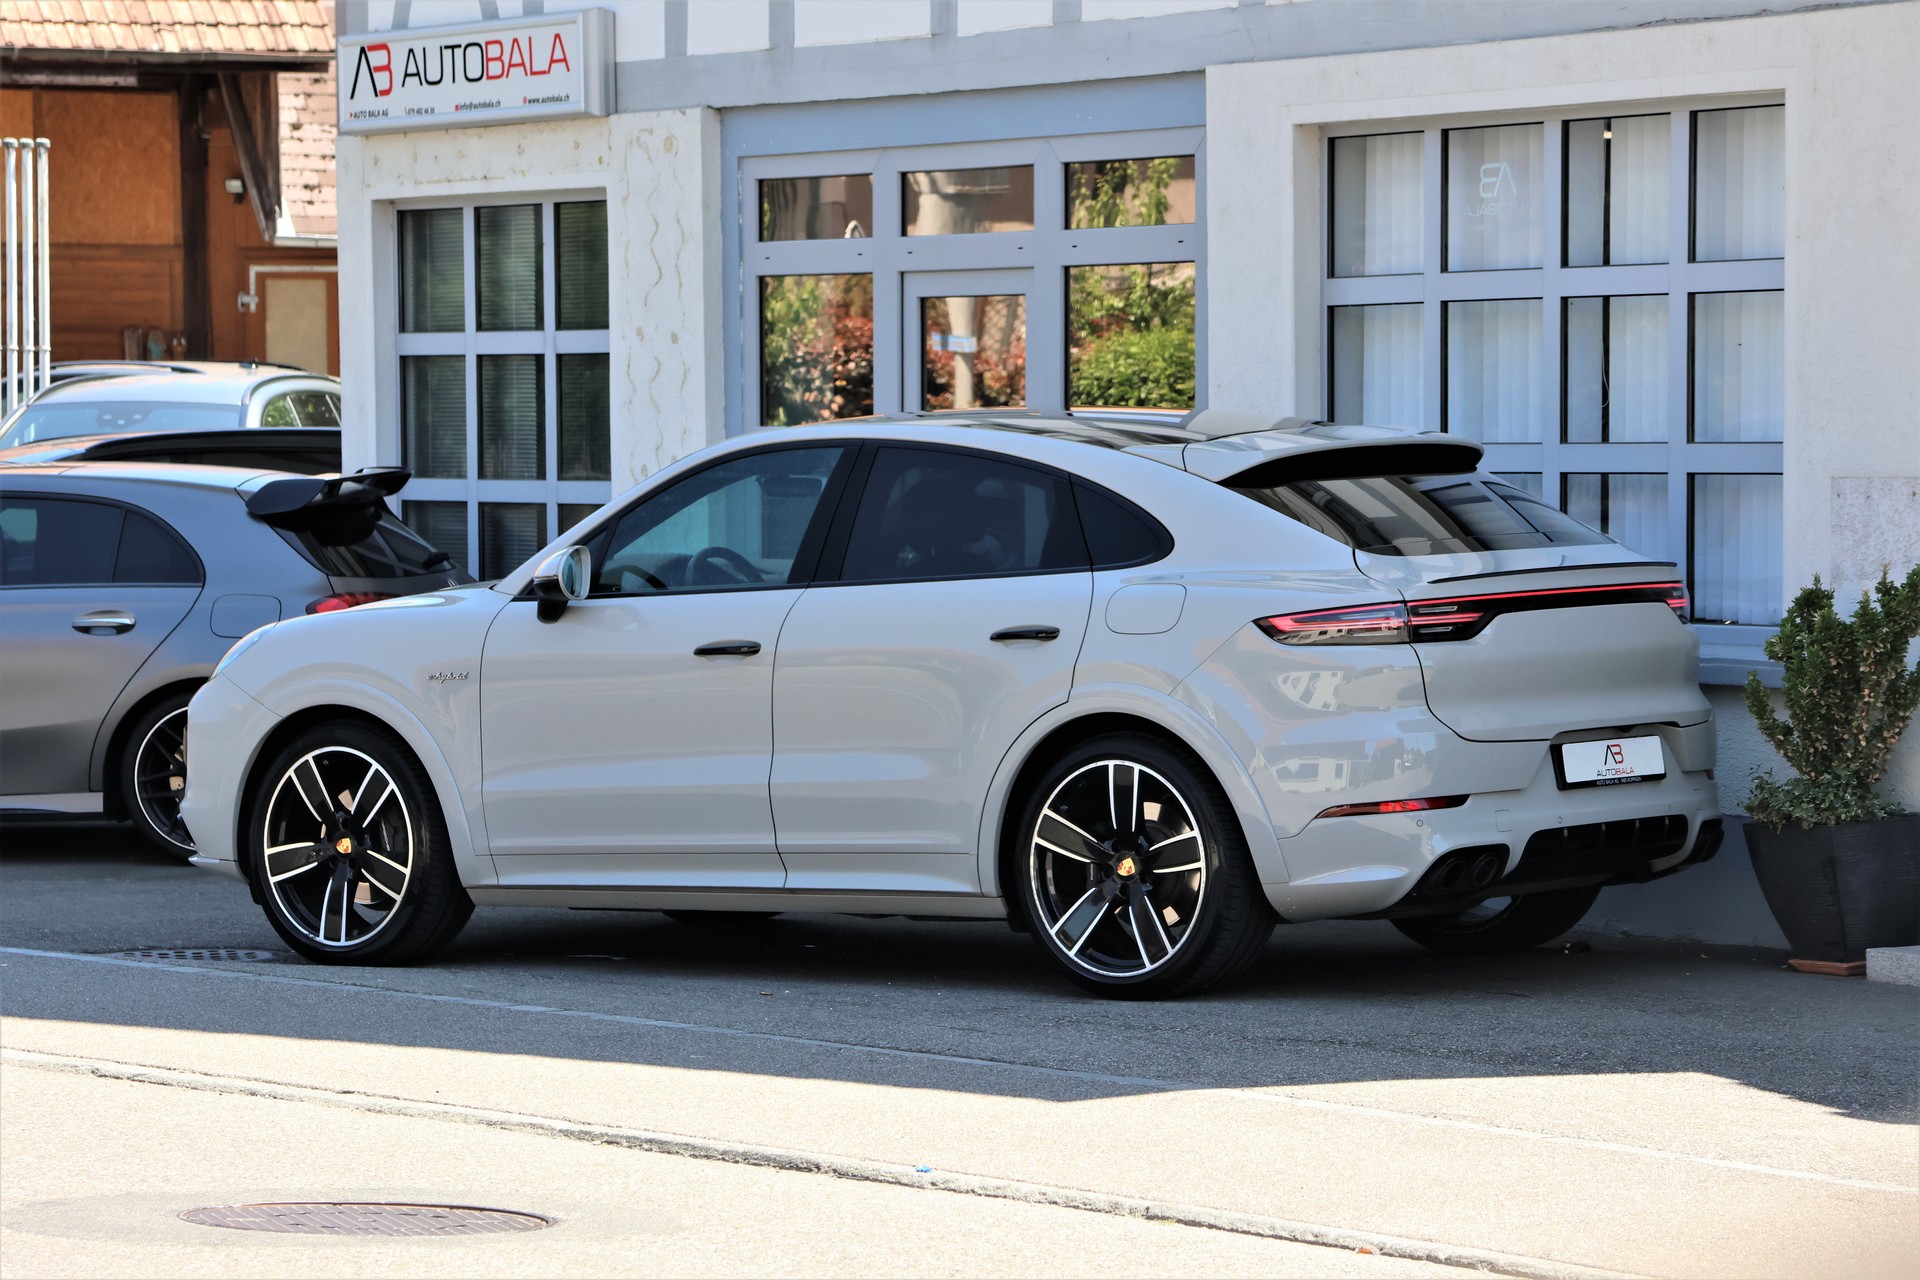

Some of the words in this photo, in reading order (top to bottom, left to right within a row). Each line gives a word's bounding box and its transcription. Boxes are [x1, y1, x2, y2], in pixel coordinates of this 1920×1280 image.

[402, 33, 570, 87] AUTOBALA
[527, 93, 570, 104] www.autobala.ch
[353, 111, 367, 119] AUTO
[368, 110, 380, 118] BALA
[381, 108, 389, 117] AG
[1597, 767, 1634, 777] AUTOBALA
